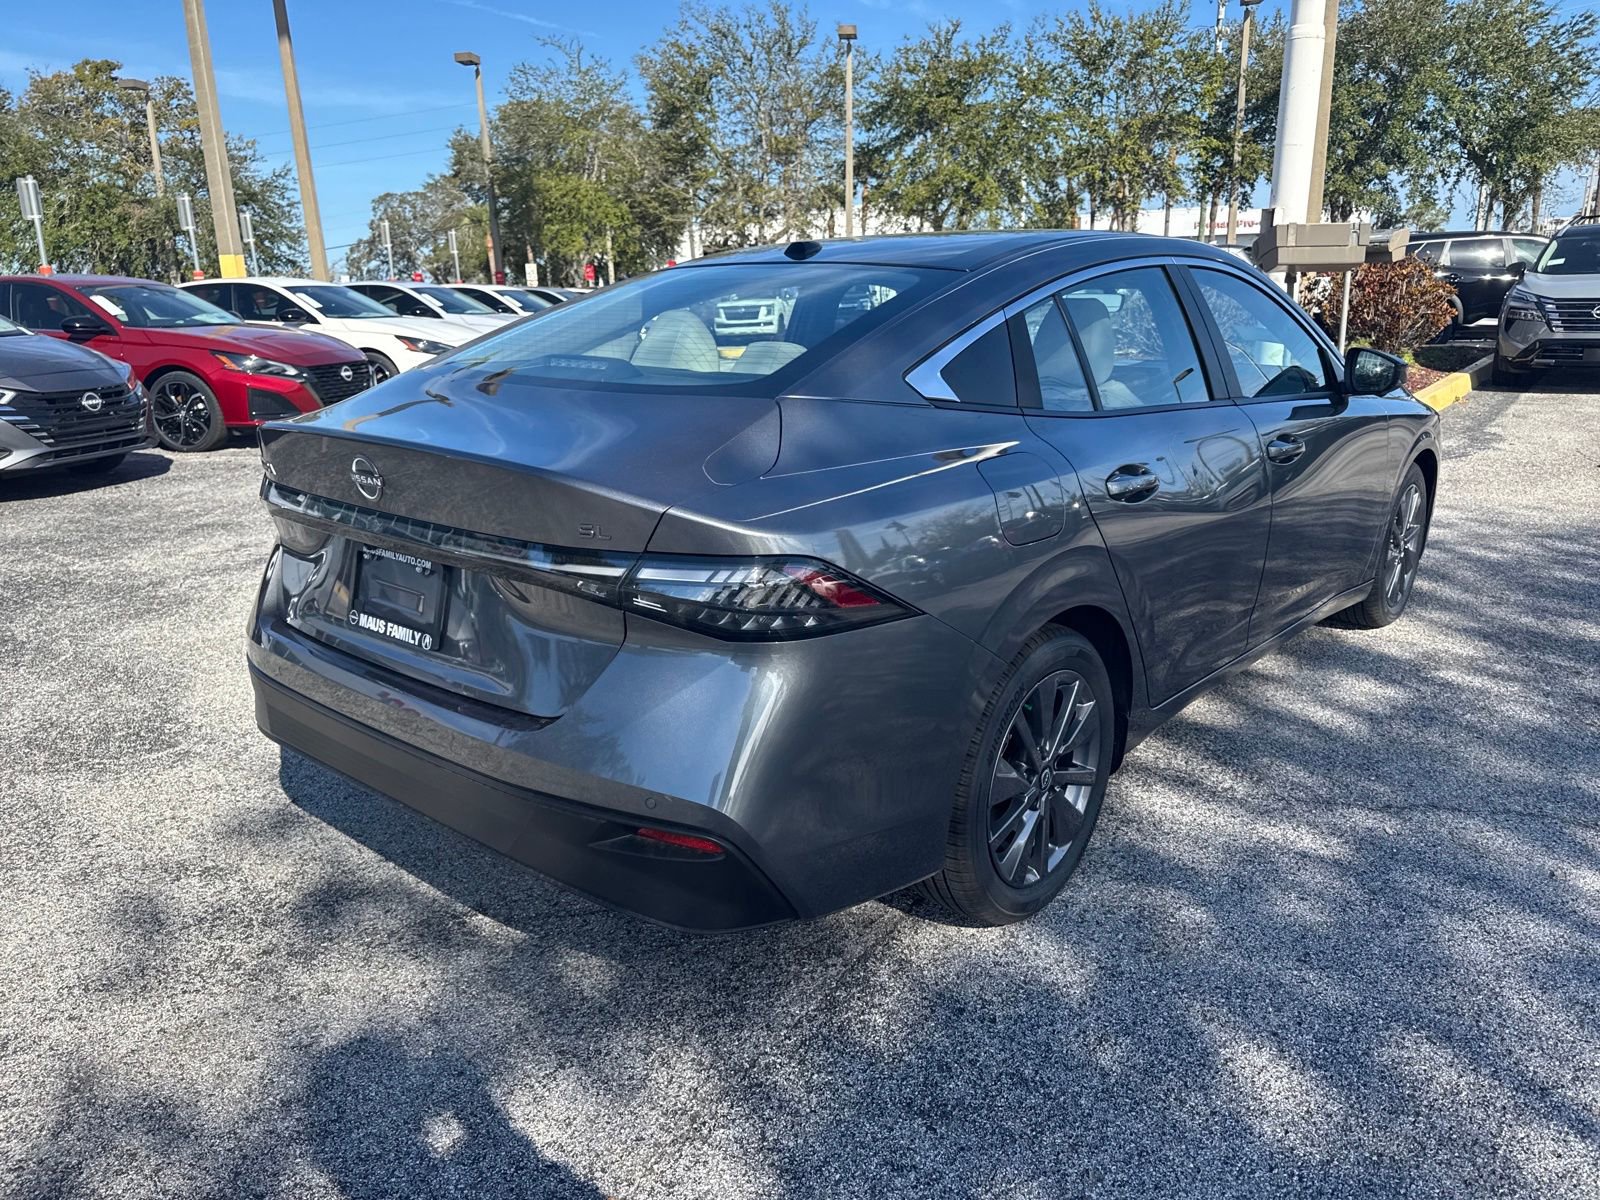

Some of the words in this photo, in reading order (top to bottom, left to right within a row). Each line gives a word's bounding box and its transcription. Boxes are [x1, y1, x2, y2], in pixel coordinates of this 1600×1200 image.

[579, 523, 612, 541] SL
[359, 613, 386, 634] MAUS
[386, 622, 422, 646] FAMILY
